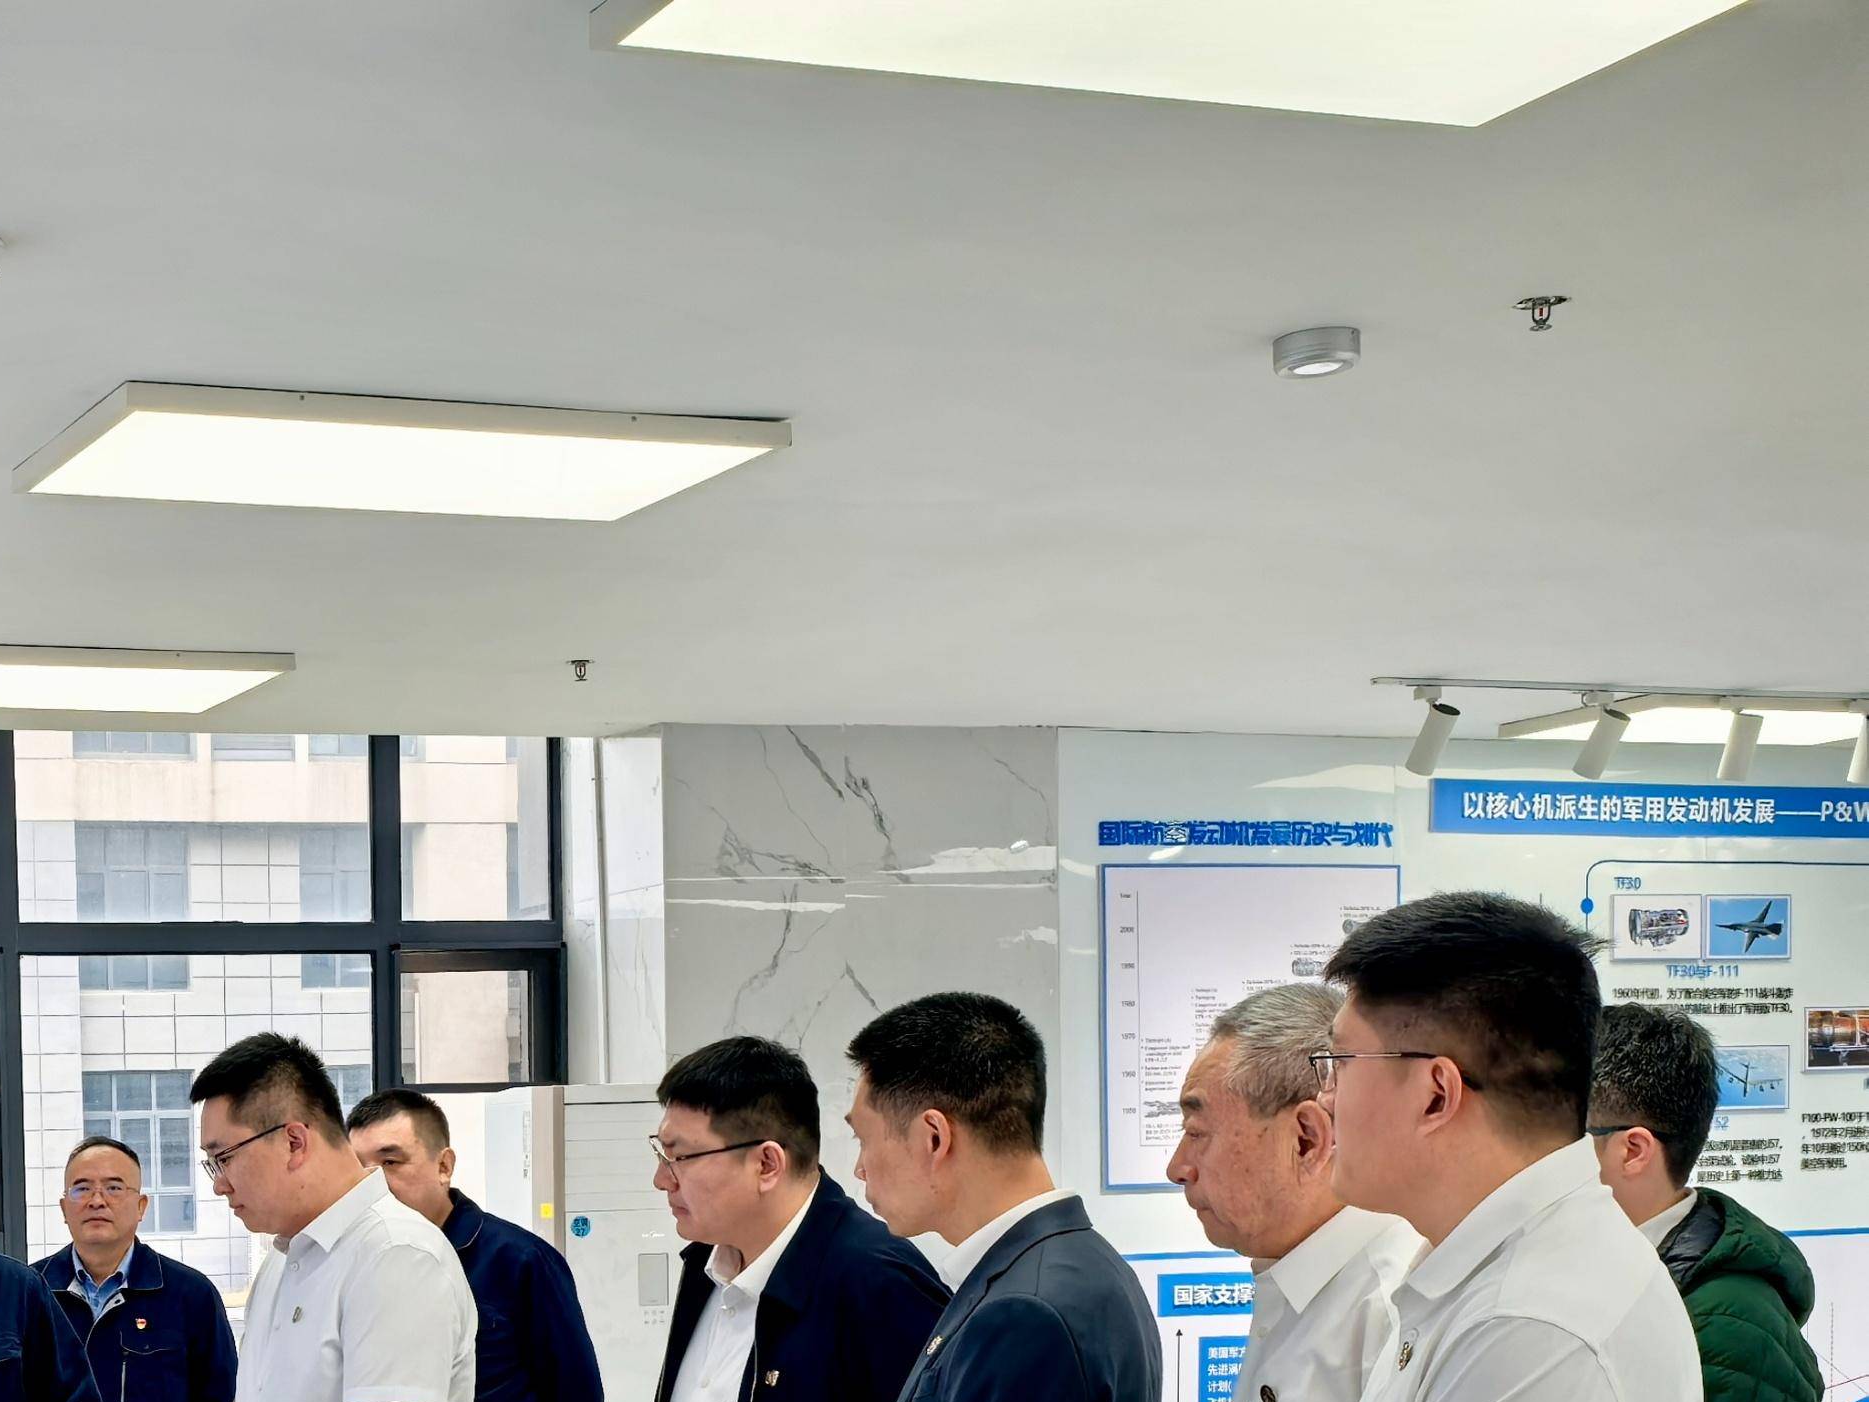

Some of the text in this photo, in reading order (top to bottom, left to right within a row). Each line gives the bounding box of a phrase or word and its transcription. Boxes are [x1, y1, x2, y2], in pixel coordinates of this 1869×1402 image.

[1614, 876, 1641, 891] TF30
[1208, 1364, 1242, 1376] 先进涡
